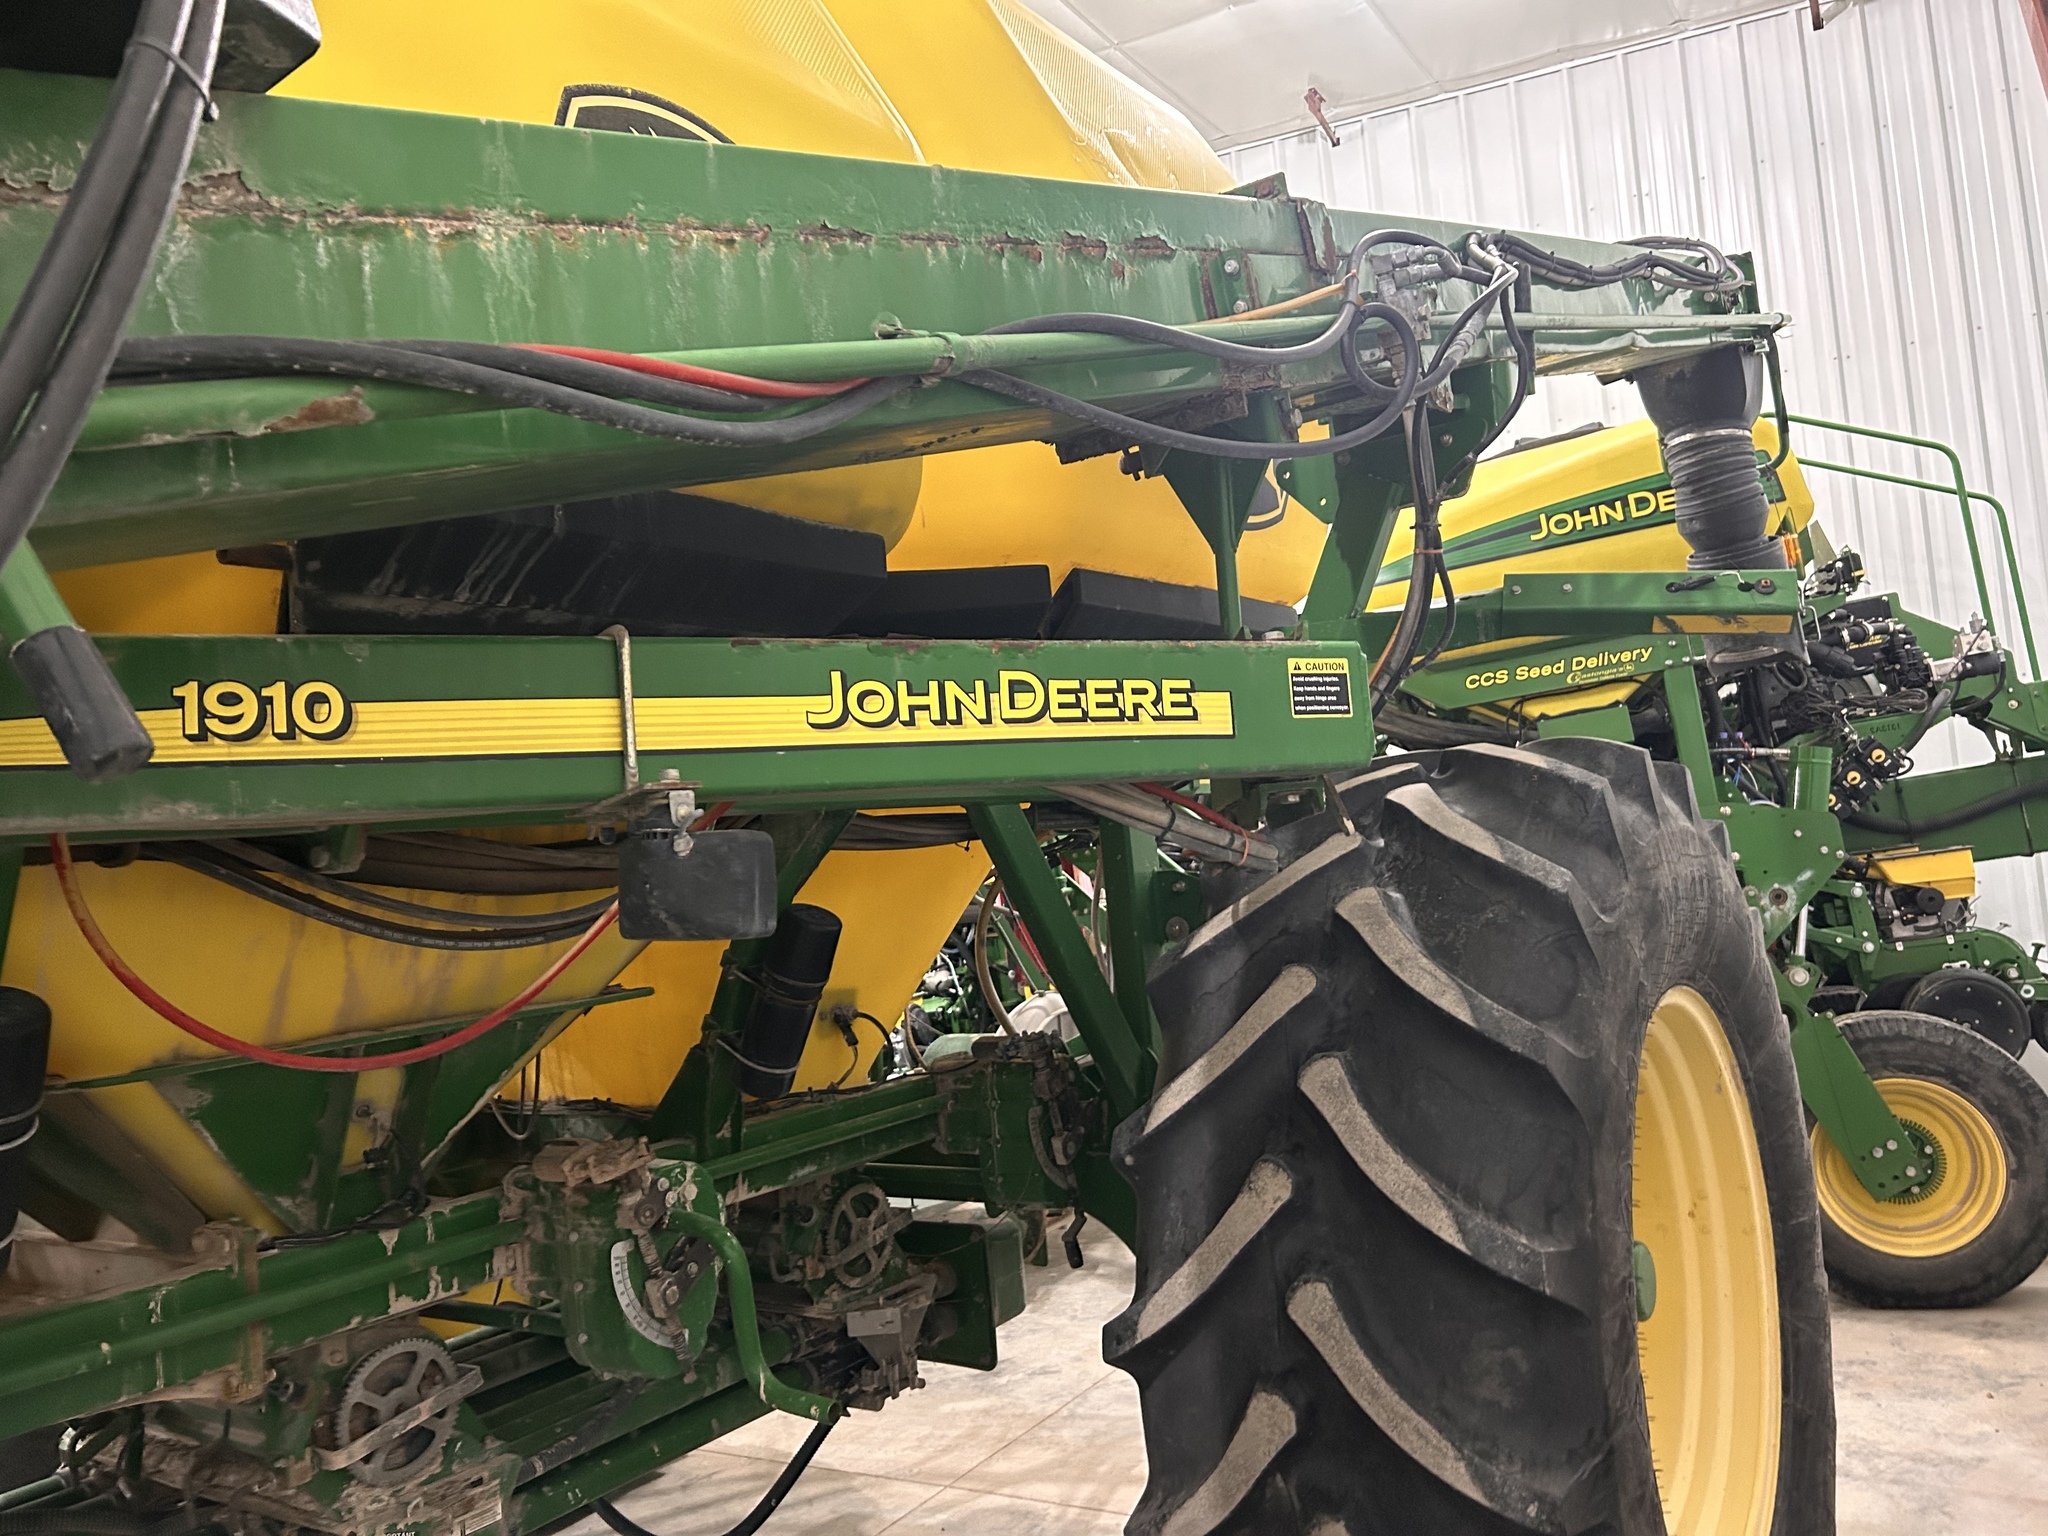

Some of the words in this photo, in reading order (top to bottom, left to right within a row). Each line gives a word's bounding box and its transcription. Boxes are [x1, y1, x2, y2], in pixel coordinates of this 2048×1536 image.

[1530, 500, 1625, 541] JOHN
[1305, 662, 1344, 671] CAUTION
[1465, 670, 1508, 689] CCS
[1515, 660, 1565, 681] Seed
[1571, 646, 1653, 672] Delivery
[171, 680, 352, 742] 1910
[806, 670, 993, 730] JOHN
[998, 669, 1198, 724] DEERE
